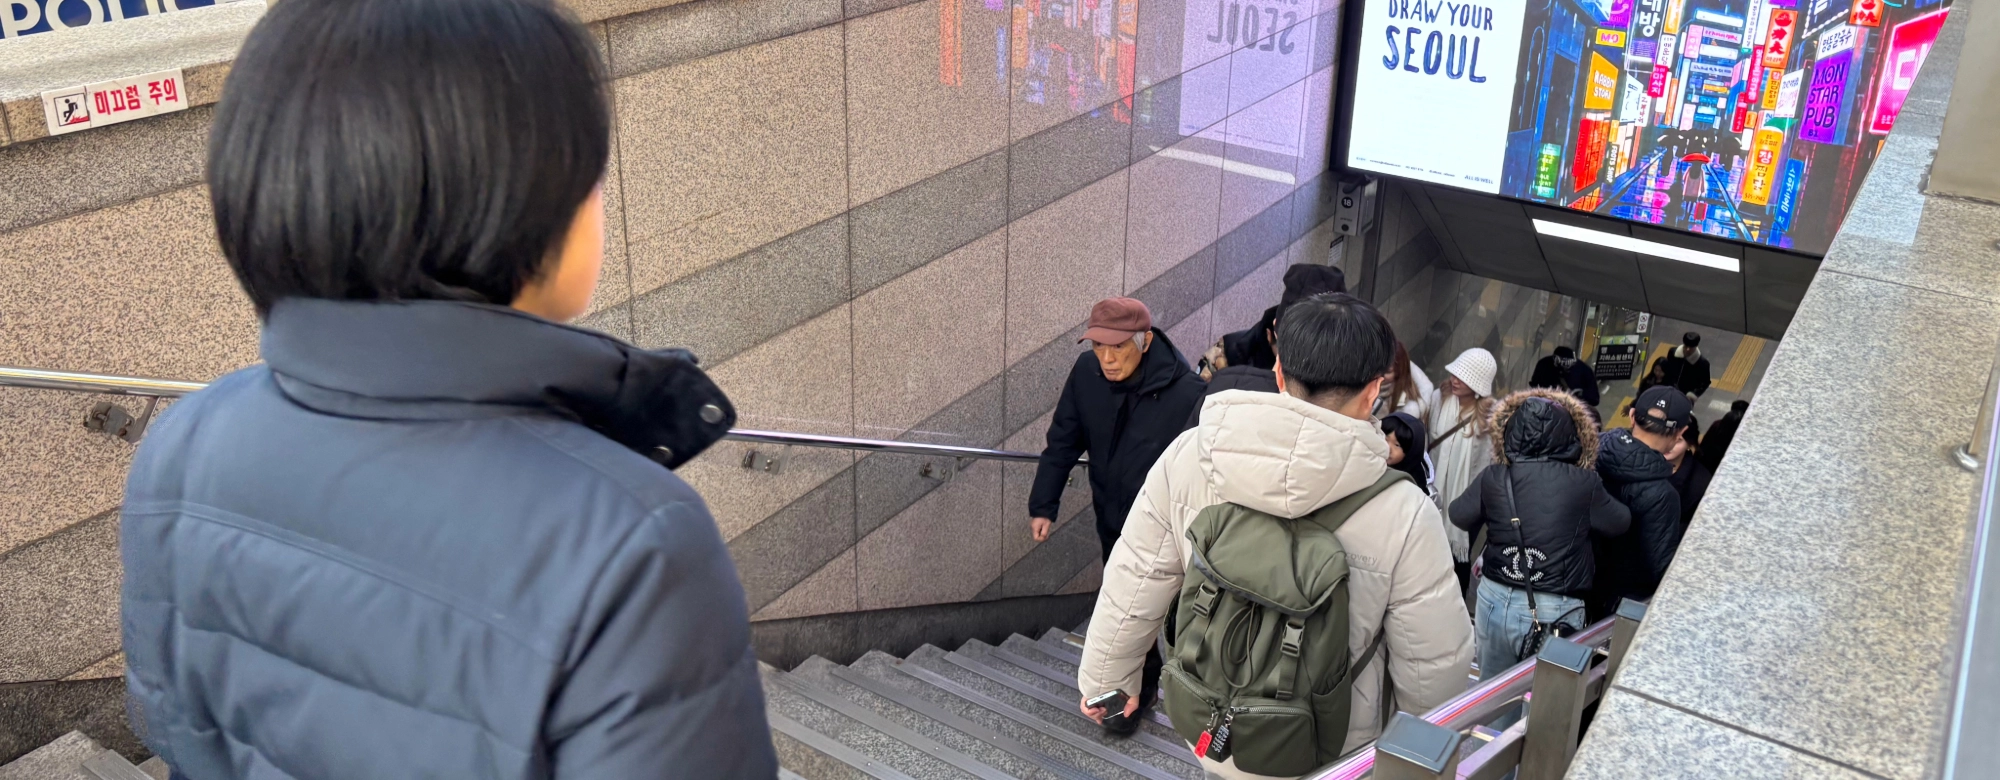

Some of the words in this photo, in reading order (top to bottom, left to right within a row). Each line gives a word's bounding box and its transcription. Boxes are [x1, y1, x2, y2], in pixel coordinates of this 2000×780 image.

[1389, 0, 1443, 23] DRAW
[1447, 2, 1493, 31] YOUR
[1382, 25, 1487, 83] SEOUL
[1651, 72, 1665, 95] 마사지
[1813, 63, 1846, 87] MON
[93, 85, 141, 116] 미끄럼
[148, 78, 179, 105] 주의
[1810, 86, 1840, 105] STAR
[1804, 106, 1837, 128] PUB
[1480, 177, 1494, 185] WELL
[1345, 551, 1378, 566] covery
